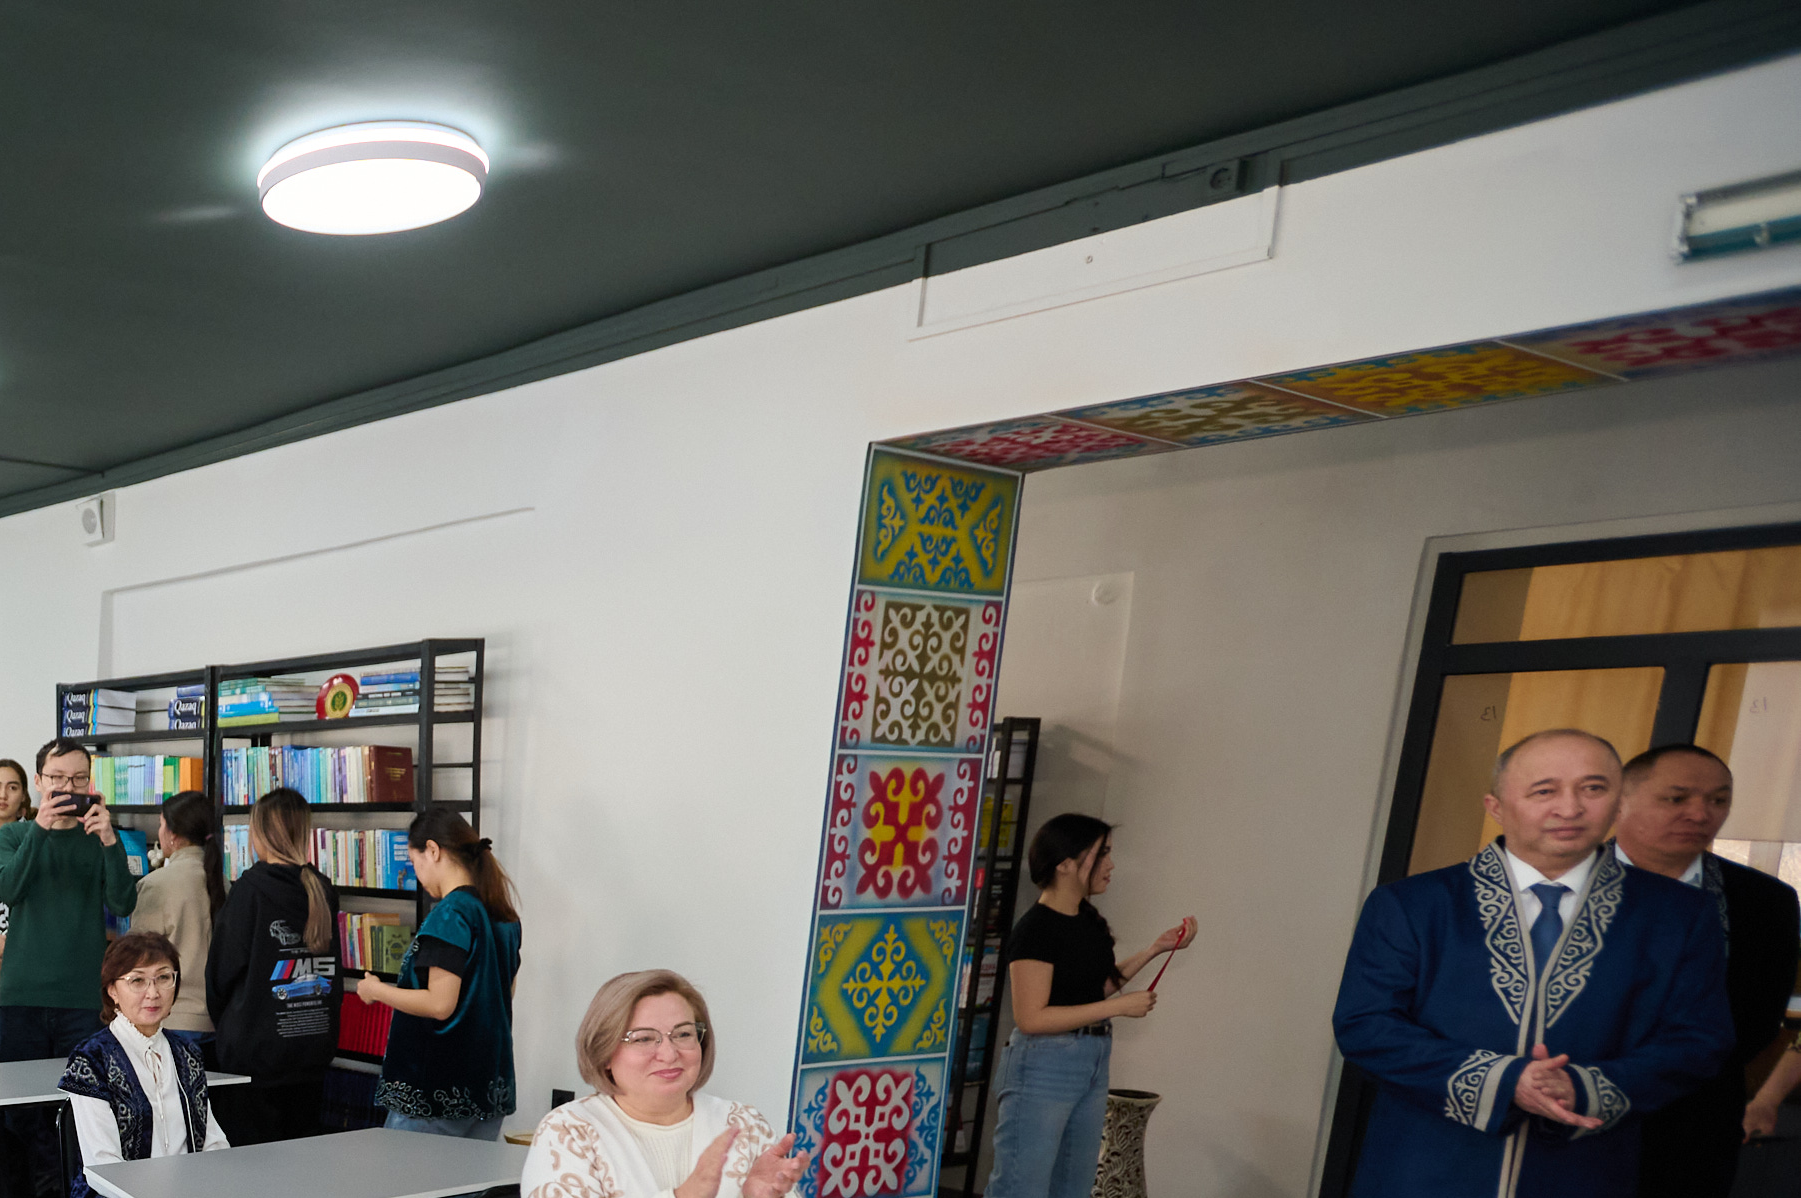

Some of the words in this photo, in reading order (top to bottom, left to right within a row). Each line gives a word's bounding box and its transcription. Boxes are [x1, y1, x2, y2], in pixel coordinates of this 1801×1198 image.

[66, 692, 86, 705] Qazaq
[173, 700, 197, 716] Qazaq
[66, 709, 86, 723] Qazaq
[292, 957, 336, 979] M5
